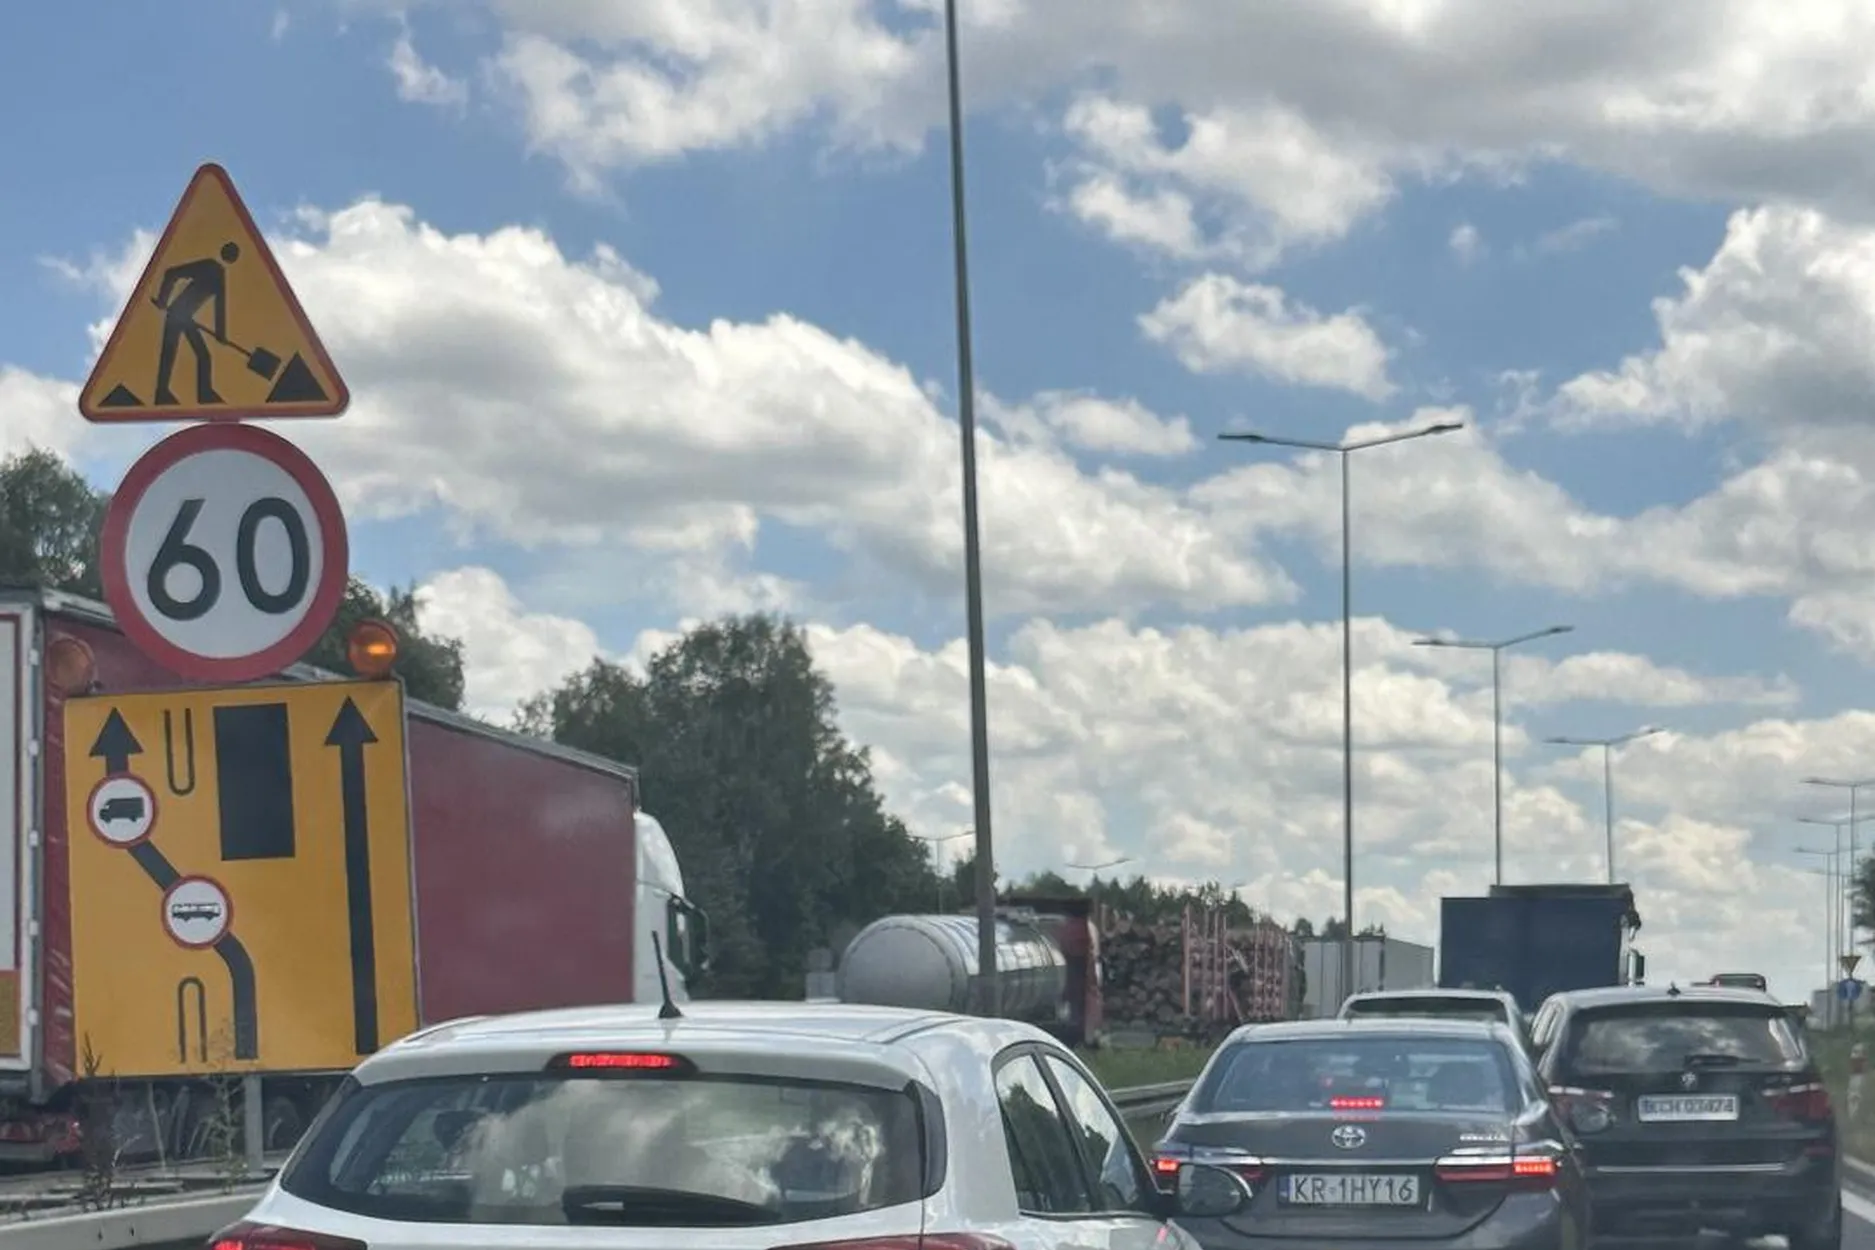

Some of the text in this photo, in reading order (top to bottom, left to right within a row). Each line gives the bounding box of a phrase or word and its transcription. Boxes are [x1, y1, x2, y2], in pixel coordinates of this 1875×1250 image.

[147, 497, 310, 621] 60
[1294, 1177, 1413, 1203] KR 1HY16
